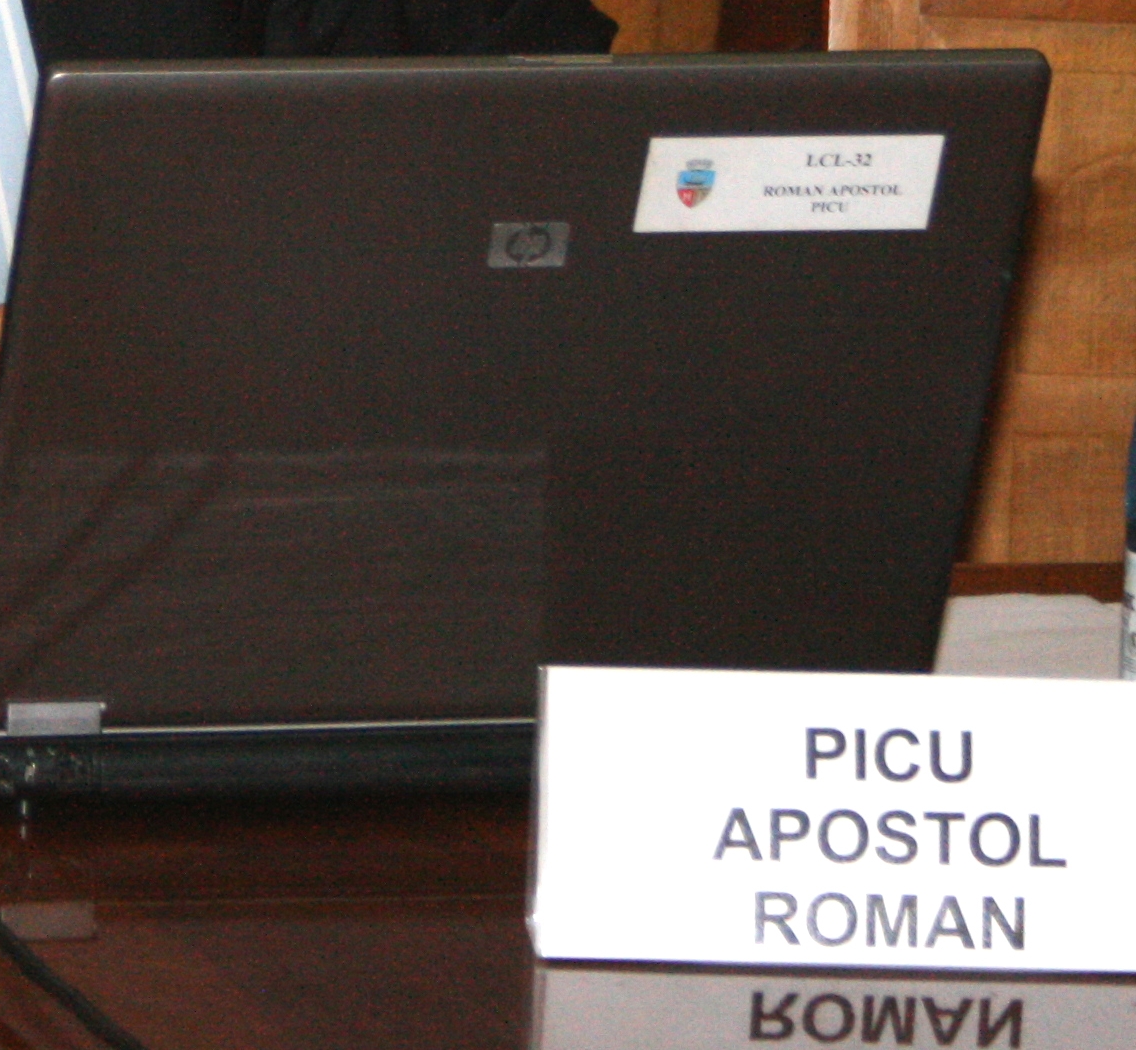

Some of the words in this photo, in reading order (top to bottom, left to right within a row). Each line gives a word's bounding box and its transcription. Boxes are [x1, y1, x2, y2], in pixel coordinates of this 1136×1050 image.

[806, 153, 873, 168] LCL-32
[763, 184, 823, 198] ROMAN
[829, 183, 902, 197] APOSTOL
[811, 201, 848, 214] PICU
[805, 726, 973, 783] PICU
[713, 807, 1068, 868] APOSTOL
[754, 891, 1025, 950] ROMAN
